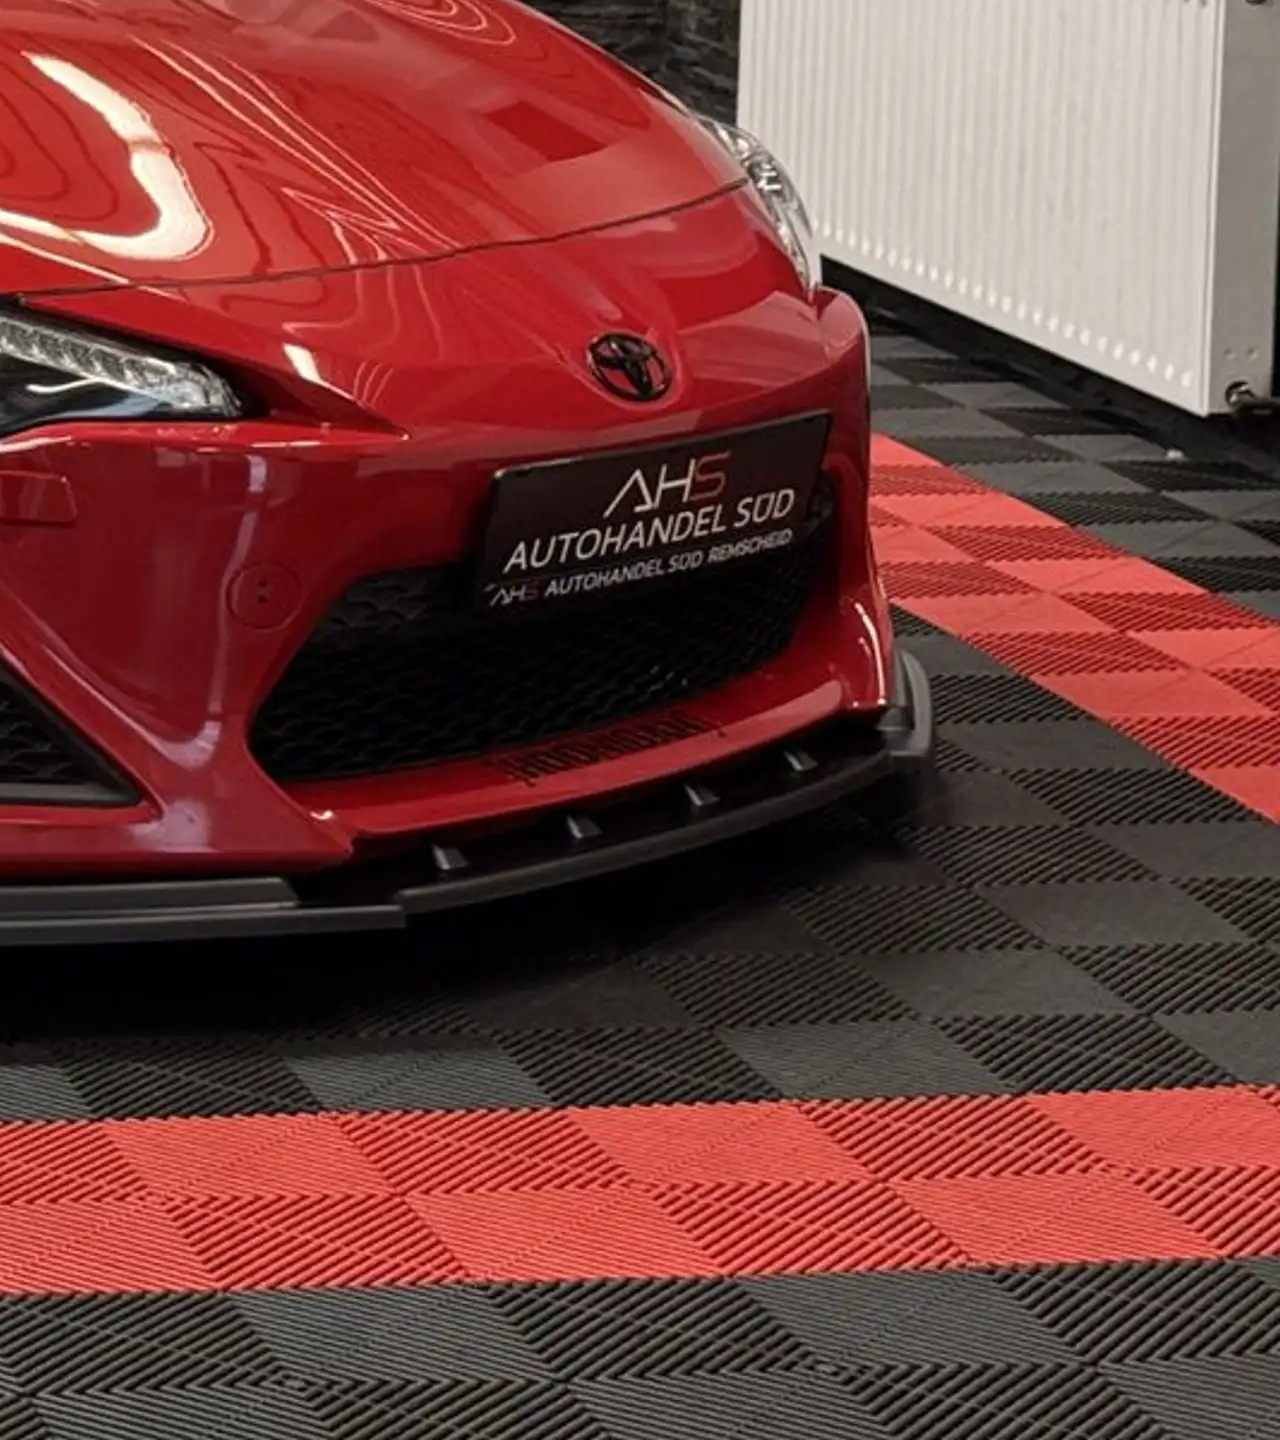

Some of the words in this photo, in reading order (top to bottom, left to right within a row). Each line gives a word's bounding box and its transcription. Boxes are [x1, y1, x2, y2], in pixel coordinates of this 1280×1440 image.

[603, 450, 732, 518] AHS
[503, 503, 727, 574] AUTOHANDEL
[733, 489, 795, 528] SÜD
[544, 559, 664, 597] AUTOHANDEL
[708, 529, 793, 563] REMSCHEID
